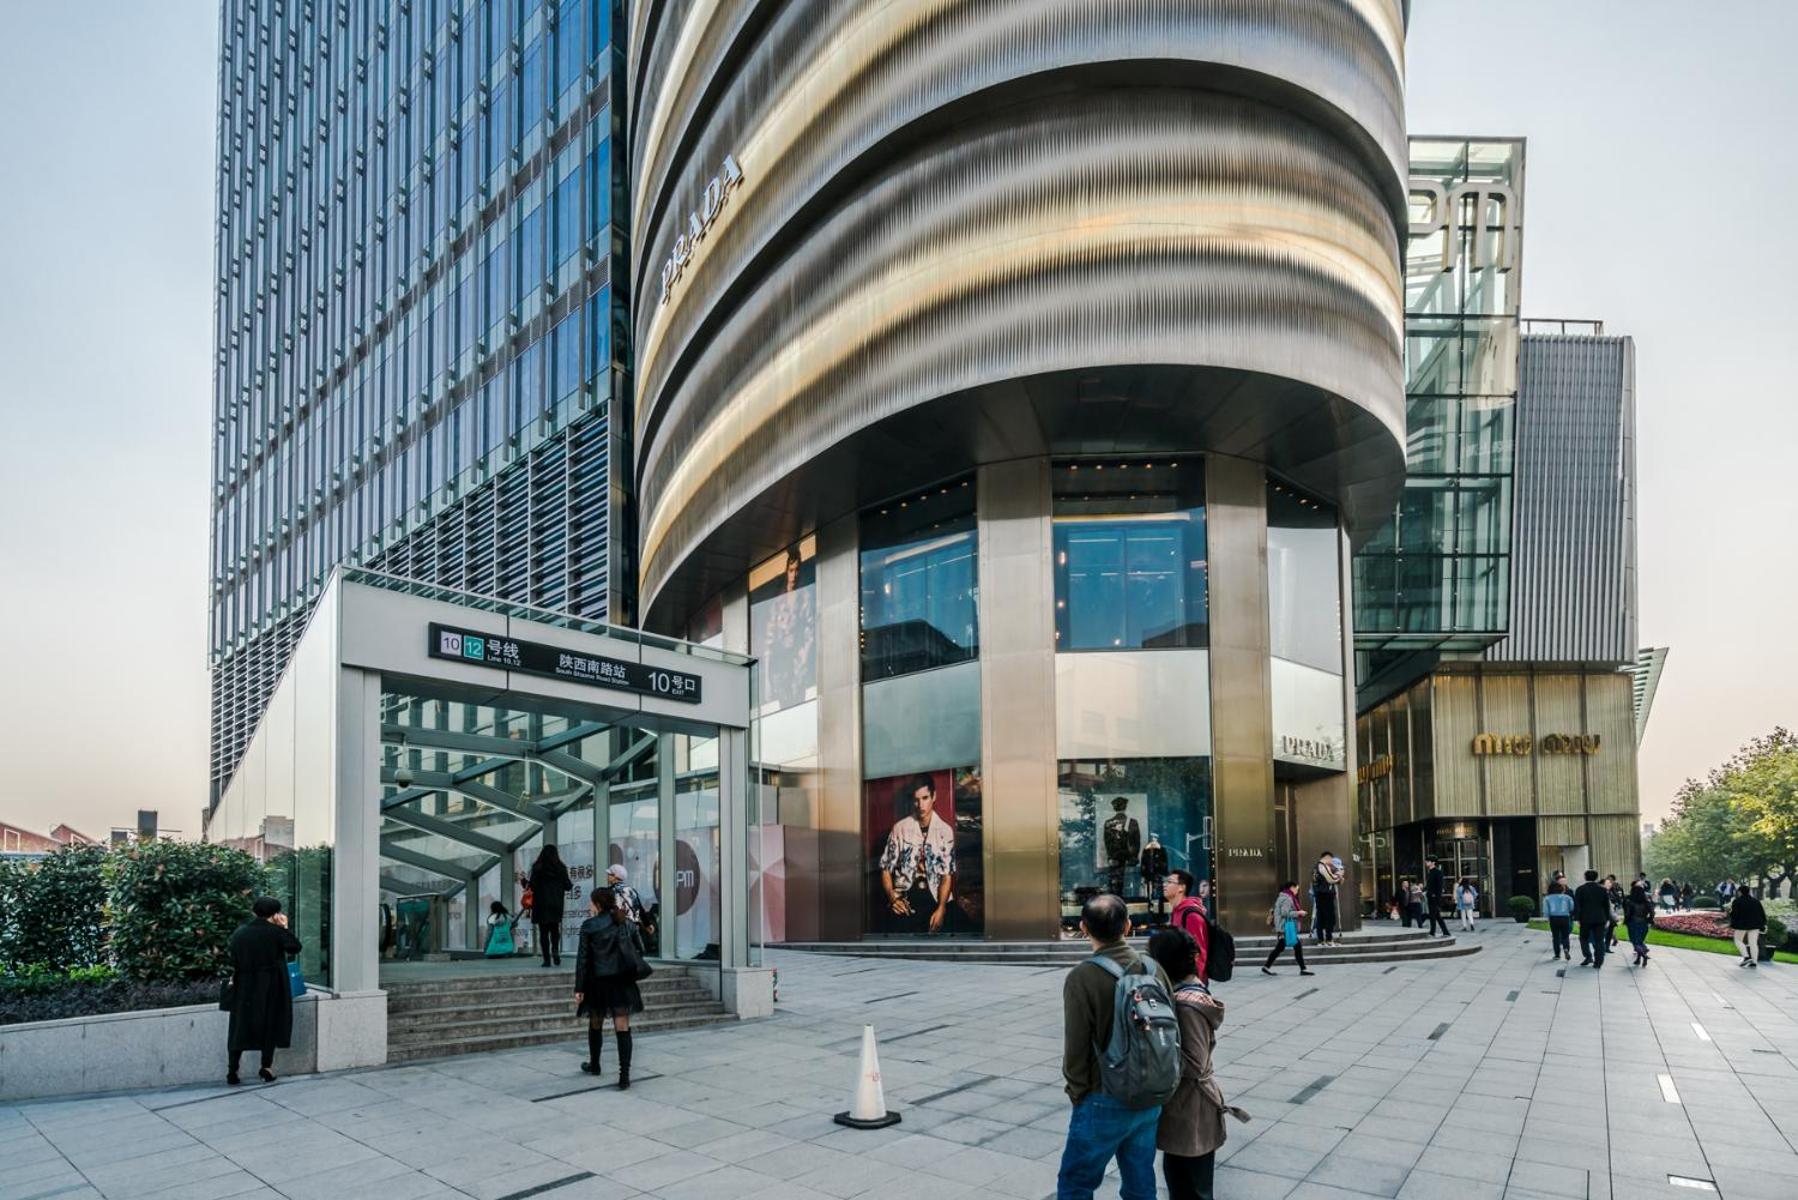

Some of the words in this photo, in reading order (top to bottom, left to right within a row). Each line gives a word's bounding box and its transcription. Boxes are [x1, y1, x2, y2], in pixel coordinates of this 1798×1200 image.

[662, 154, 742, 302] PRADA
[444, 637, 460, 651] 10
[466, 641, 482, 656] 12
[487, 640, 519, 659] 号线
[487, 654, 502, 663] Line
[560, 654, 626, 678] 陕西南路站
[1283, 735, 1335, 762] PRADA
[1228, 848, 1264, 857] PRADA
